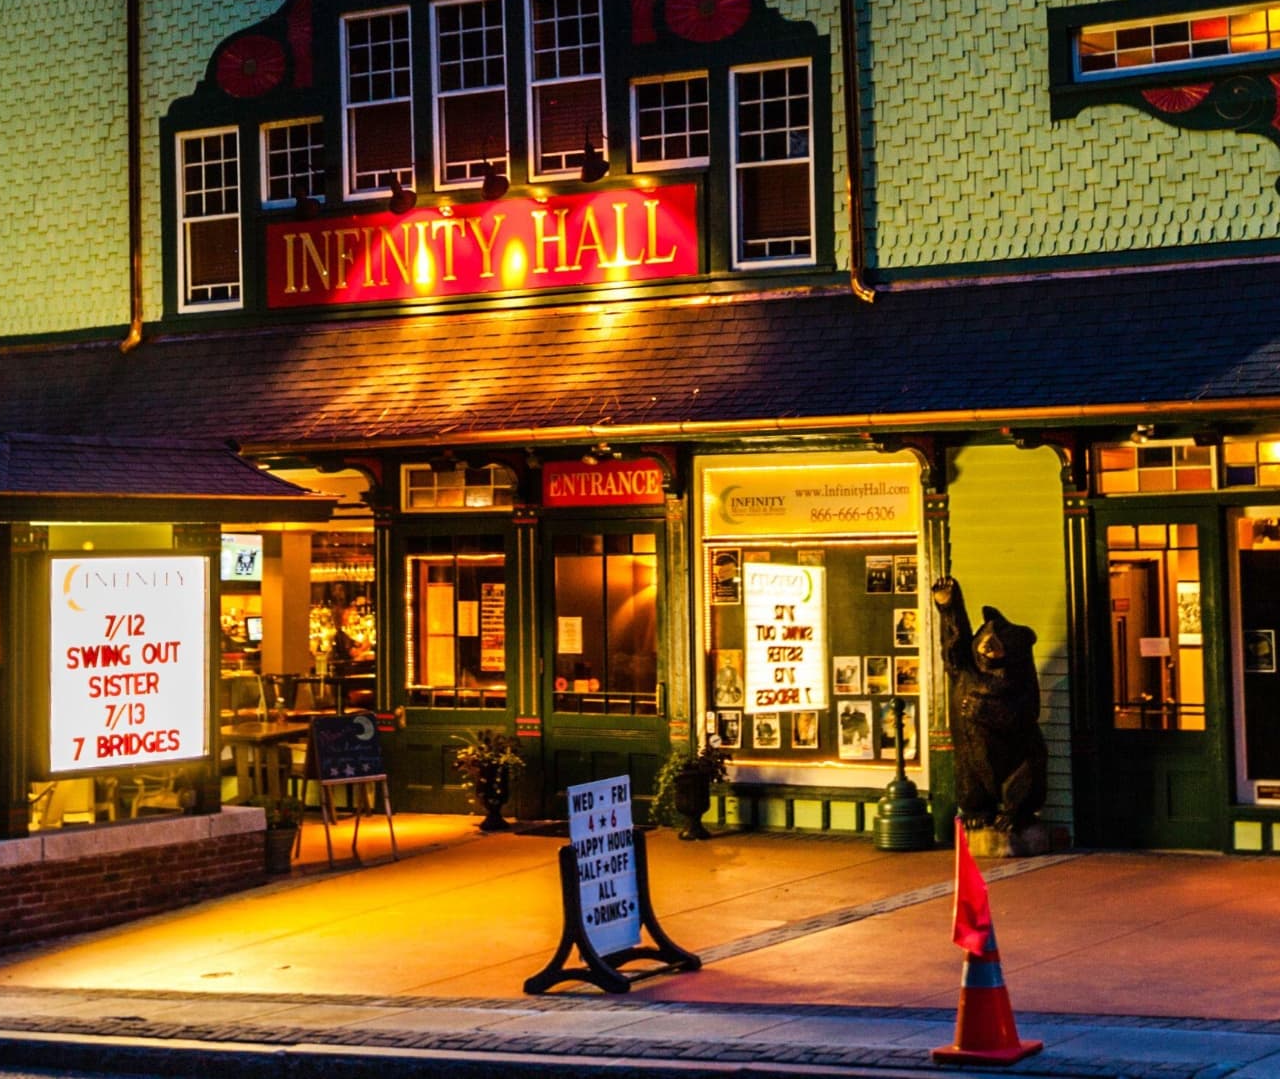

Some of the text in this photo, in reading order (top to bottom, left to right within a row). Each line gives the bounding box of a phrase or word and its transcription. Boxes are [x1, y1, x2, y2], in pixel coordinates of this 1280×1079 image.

[284, 199, 677, 293] INFINITY HALL
[549, 470, 659, 497] ENTRANCE
[795, 482, 910, 499] www.InfinityHall.com
[731, 495, 786, 507] INFINITY
[810, 506, 895, 522] 866-666-6306
[105, 614, 145, 640] 7/12
[66, 641, 181, 669] SWING OUT
[89, 672, 160, 698] SISTER
[105, 703, 145, 730] 7/13
[73, 729, 181, 761] 7 BRIDGES
[572, 792, 594, 813] WED
[612, 783, 627, 804] FRI
[588, 809, 617, 832] 4 6
[573, 829, 632, 859] HAPPY HOUR
[578, 852, 628, 881] HALF OFF
[599, 880, 616, 901] ALL
[594, 899, 628, 926] DRINKS
